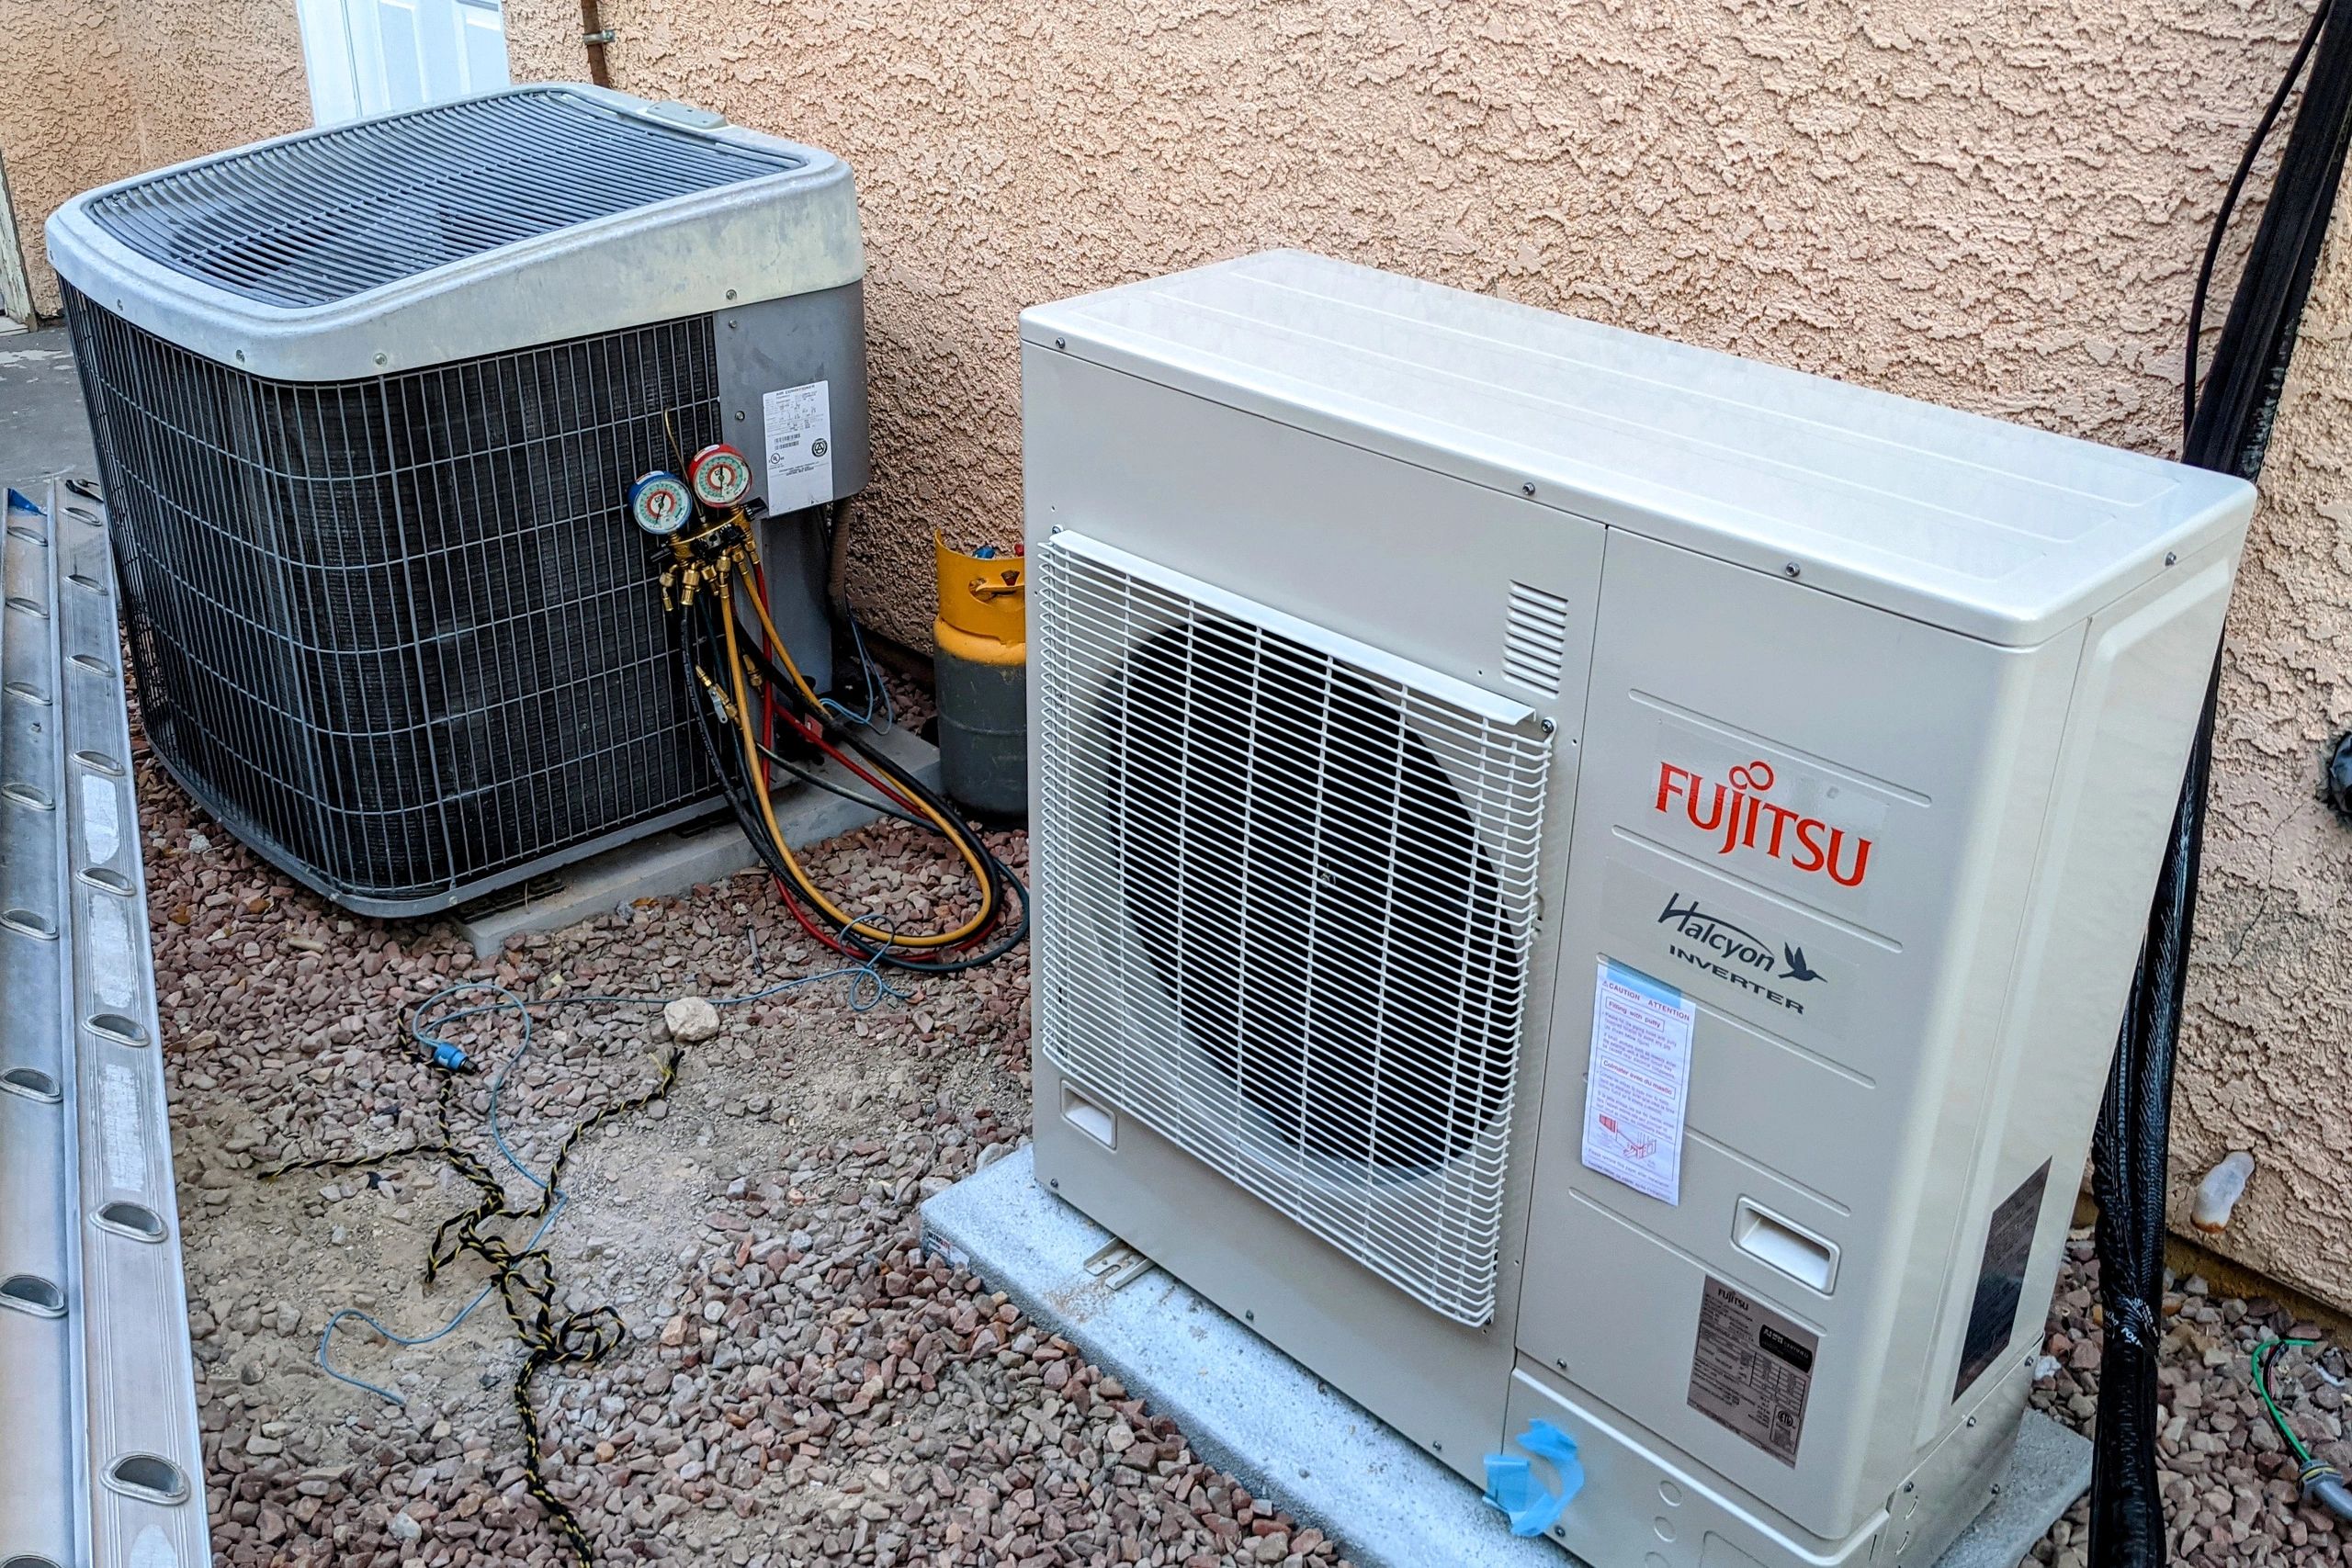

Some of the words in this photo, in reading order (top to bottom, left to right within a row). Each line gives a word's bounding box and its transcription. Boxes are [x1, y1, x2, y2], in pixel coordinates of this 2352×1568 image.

[1654, 760, 1872, 887] FUJITSU
[1657, 892, 1775, 972] Halcyon
[1609, 982, 1640, 1000] CAUTION
[1648, 998, 1689, 1021] ATTENTION
[1669, 944, 1805, 1015] INVERTER
[1629, 1009, 1642, 1020] with
[1644, 1016, 1660, 1028] putty
[1718, 1288, 1749, 1311] FUJITSU
